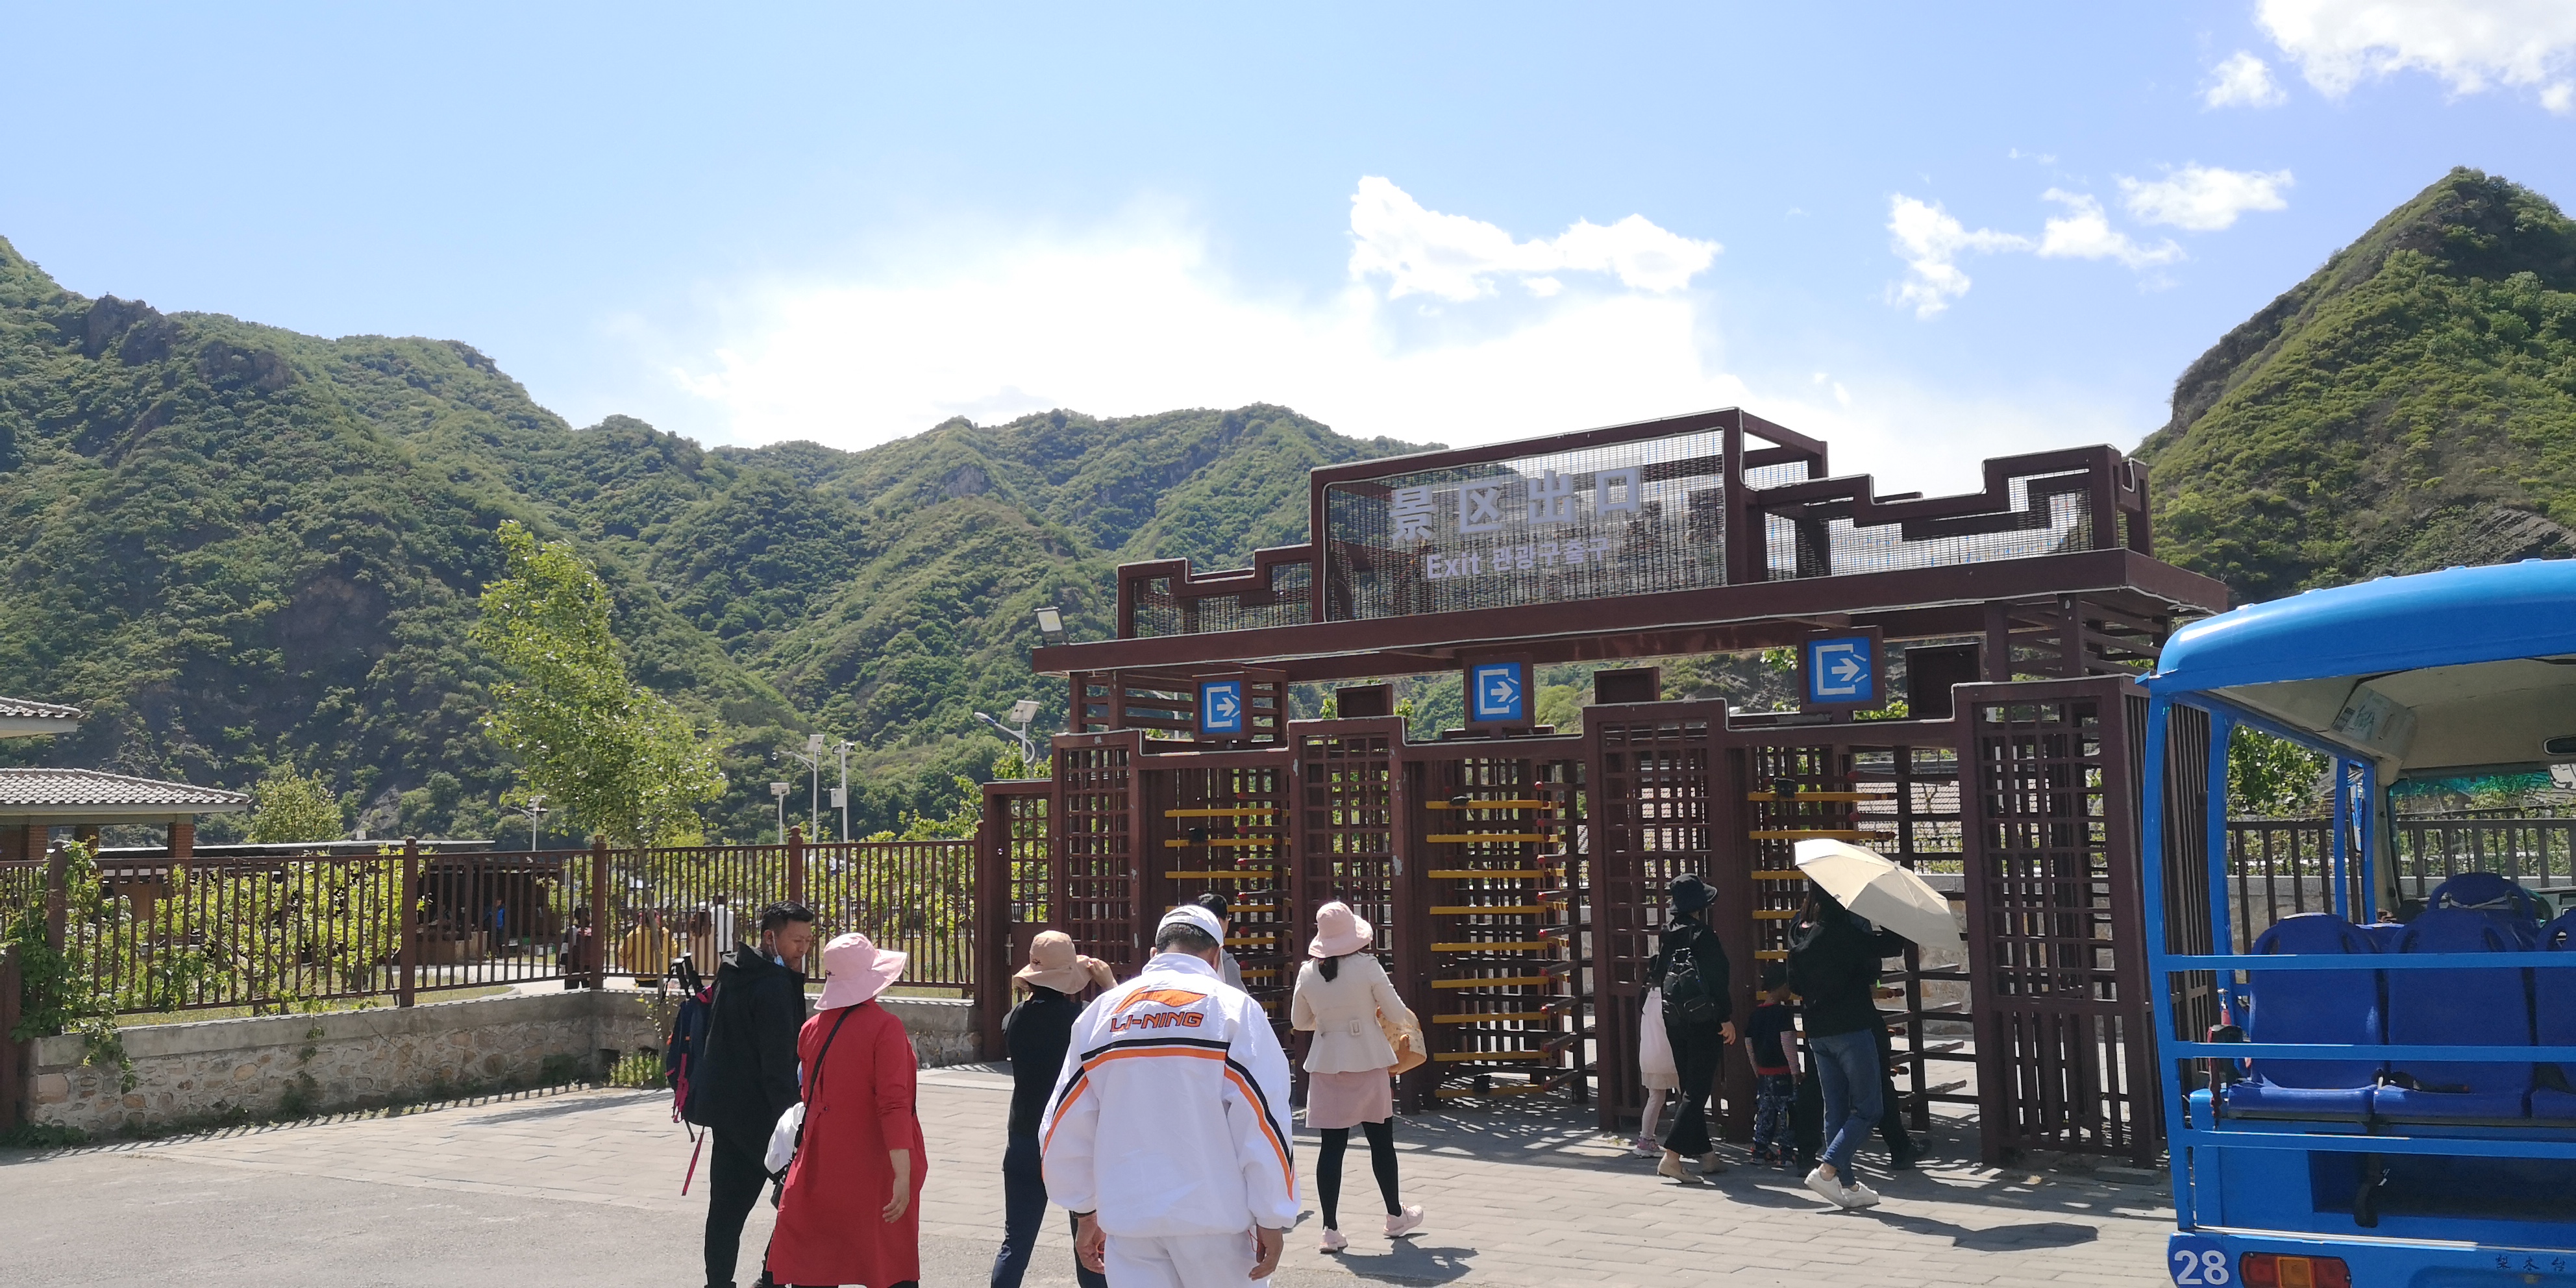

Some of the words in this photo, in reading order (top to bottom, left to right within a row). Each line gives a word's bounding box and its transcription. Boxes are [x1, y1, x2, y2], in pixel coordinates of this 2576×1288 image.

[1389, 467, 1641, 542] 景区出口
[1427, 552, 1481, 578] Exit
[1492, 538, 1610, 571] 관광구출구
[1110, 1011, 1204, 1032] LI-NING
[2174, 1250, 2229, 1285] 28
